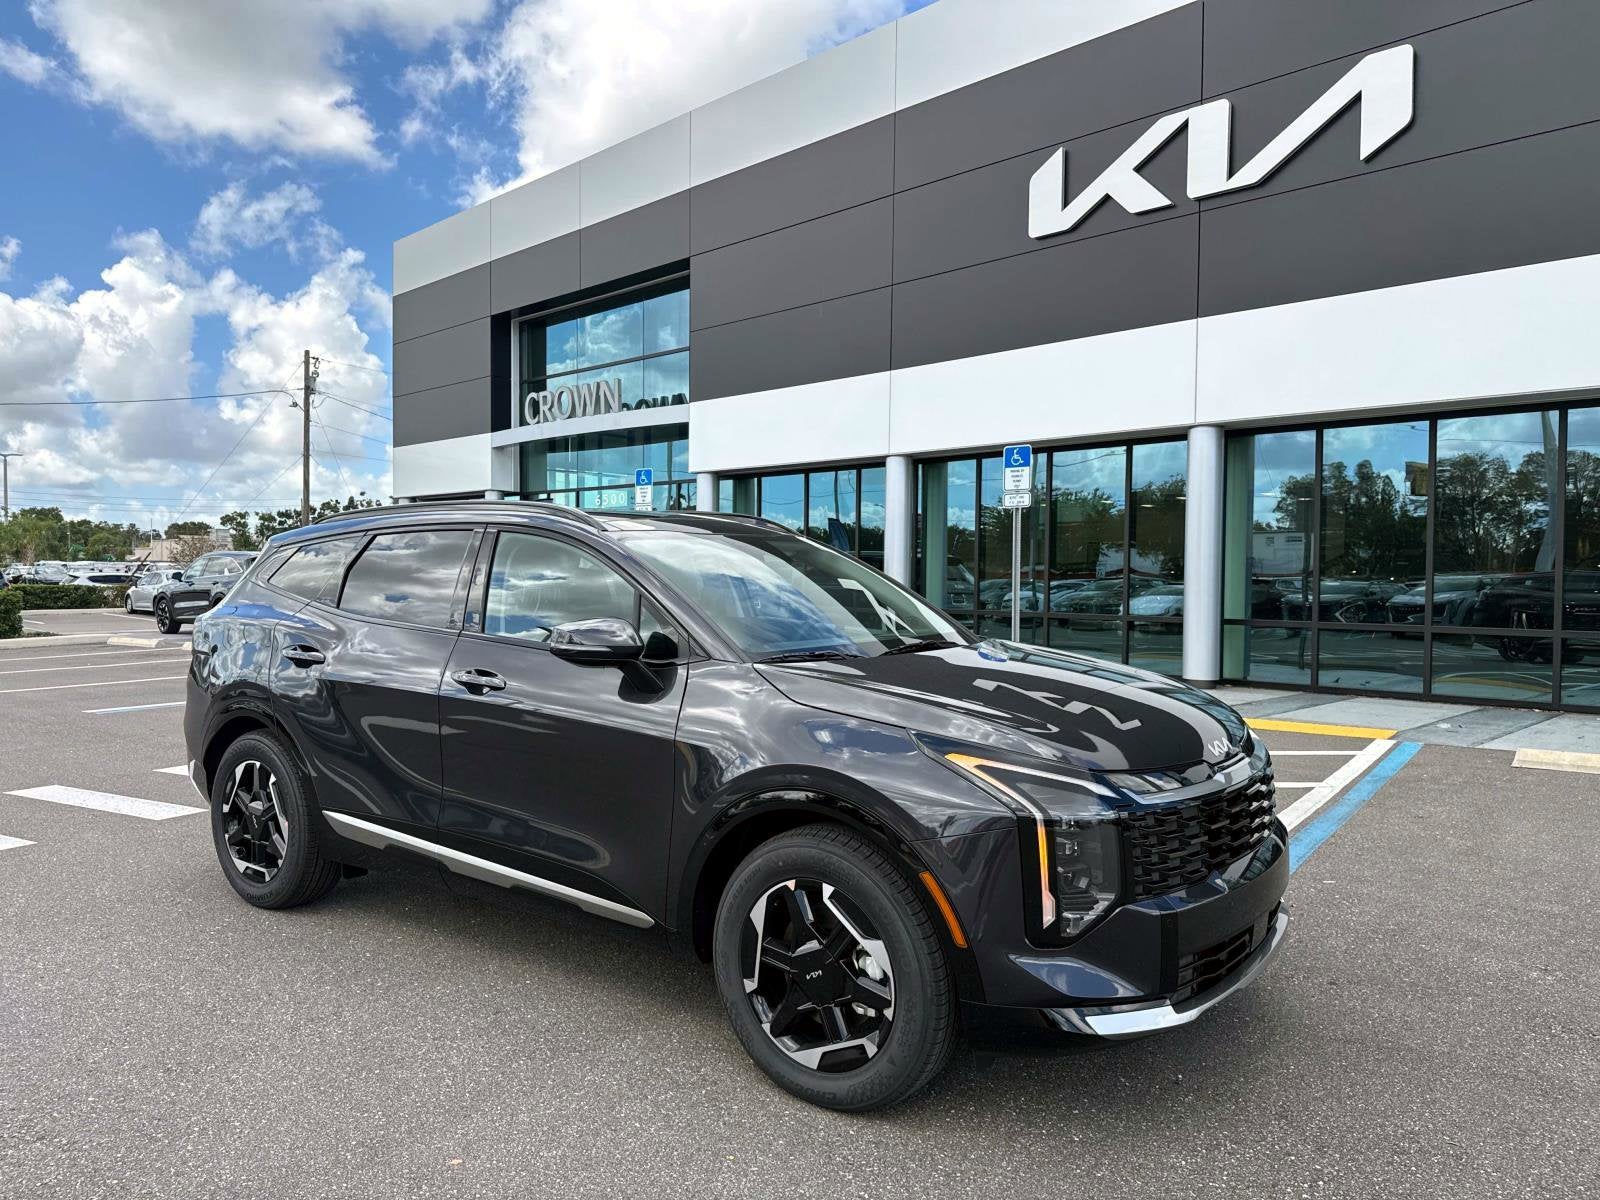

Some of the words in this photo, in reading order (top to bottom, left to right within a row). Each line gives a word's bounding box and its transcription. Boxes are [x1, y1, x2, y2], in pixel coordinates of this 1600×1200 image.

[1028, 43, 1414, 239] KIA
[525, 378, 621, 425] CROWN
[595, 493, 625, 505] 6500
[1208, 737, 1233, 757] KIA
